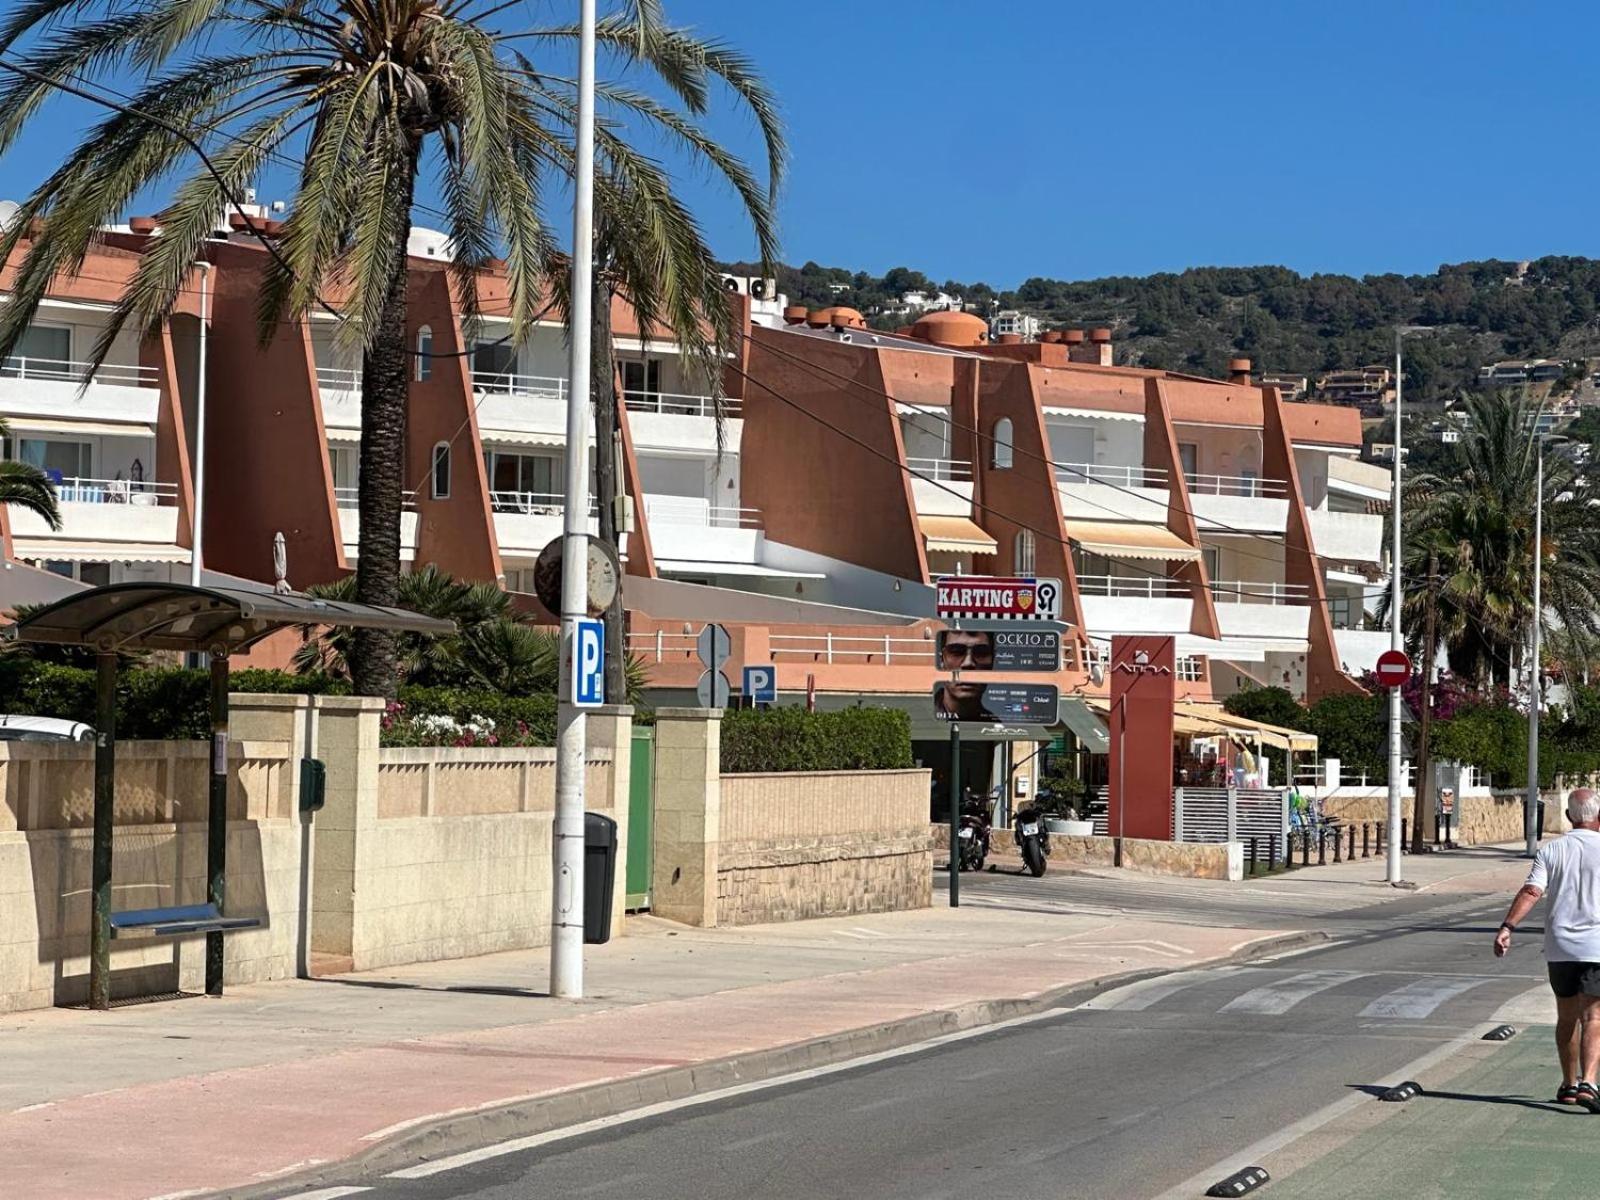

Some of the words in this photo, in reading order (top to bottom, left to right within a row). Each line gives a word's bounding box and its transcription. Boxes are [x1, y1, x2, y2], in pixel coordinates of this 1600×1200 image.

[938, 588, 1013, 608] KARTING
[996, 633, 1041, 645] OCKIO
[582, 629, 598, 696] P
[749, 670, 769, 697] P
